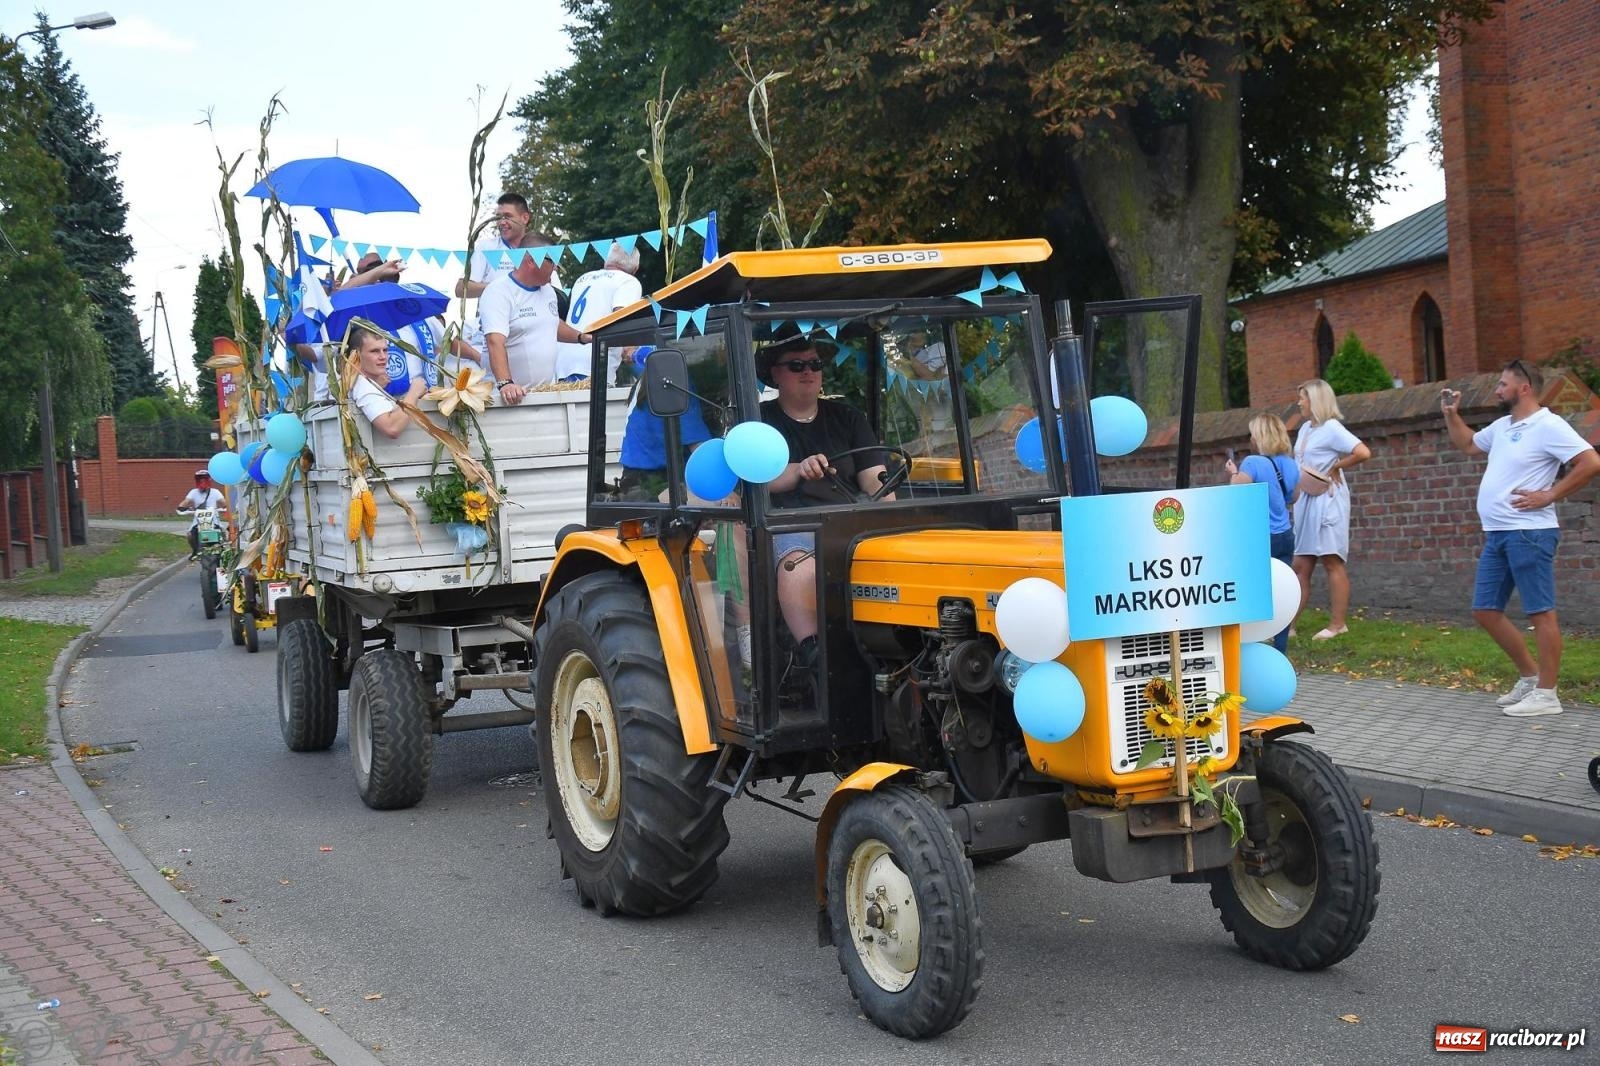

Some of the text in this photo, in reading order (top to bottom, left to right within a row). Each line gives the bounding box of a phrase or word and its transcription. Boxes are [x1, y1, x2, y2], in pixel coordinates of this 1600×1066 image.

[841, 250, 939, 266] C-360-3P
[570, 285, 591, 325] 6
[1157, 500, 1179, 511] LZS
[1128, 555, 1203, 582] LKS 07
[1094, 581, 1237, 616] MARKOWICE
